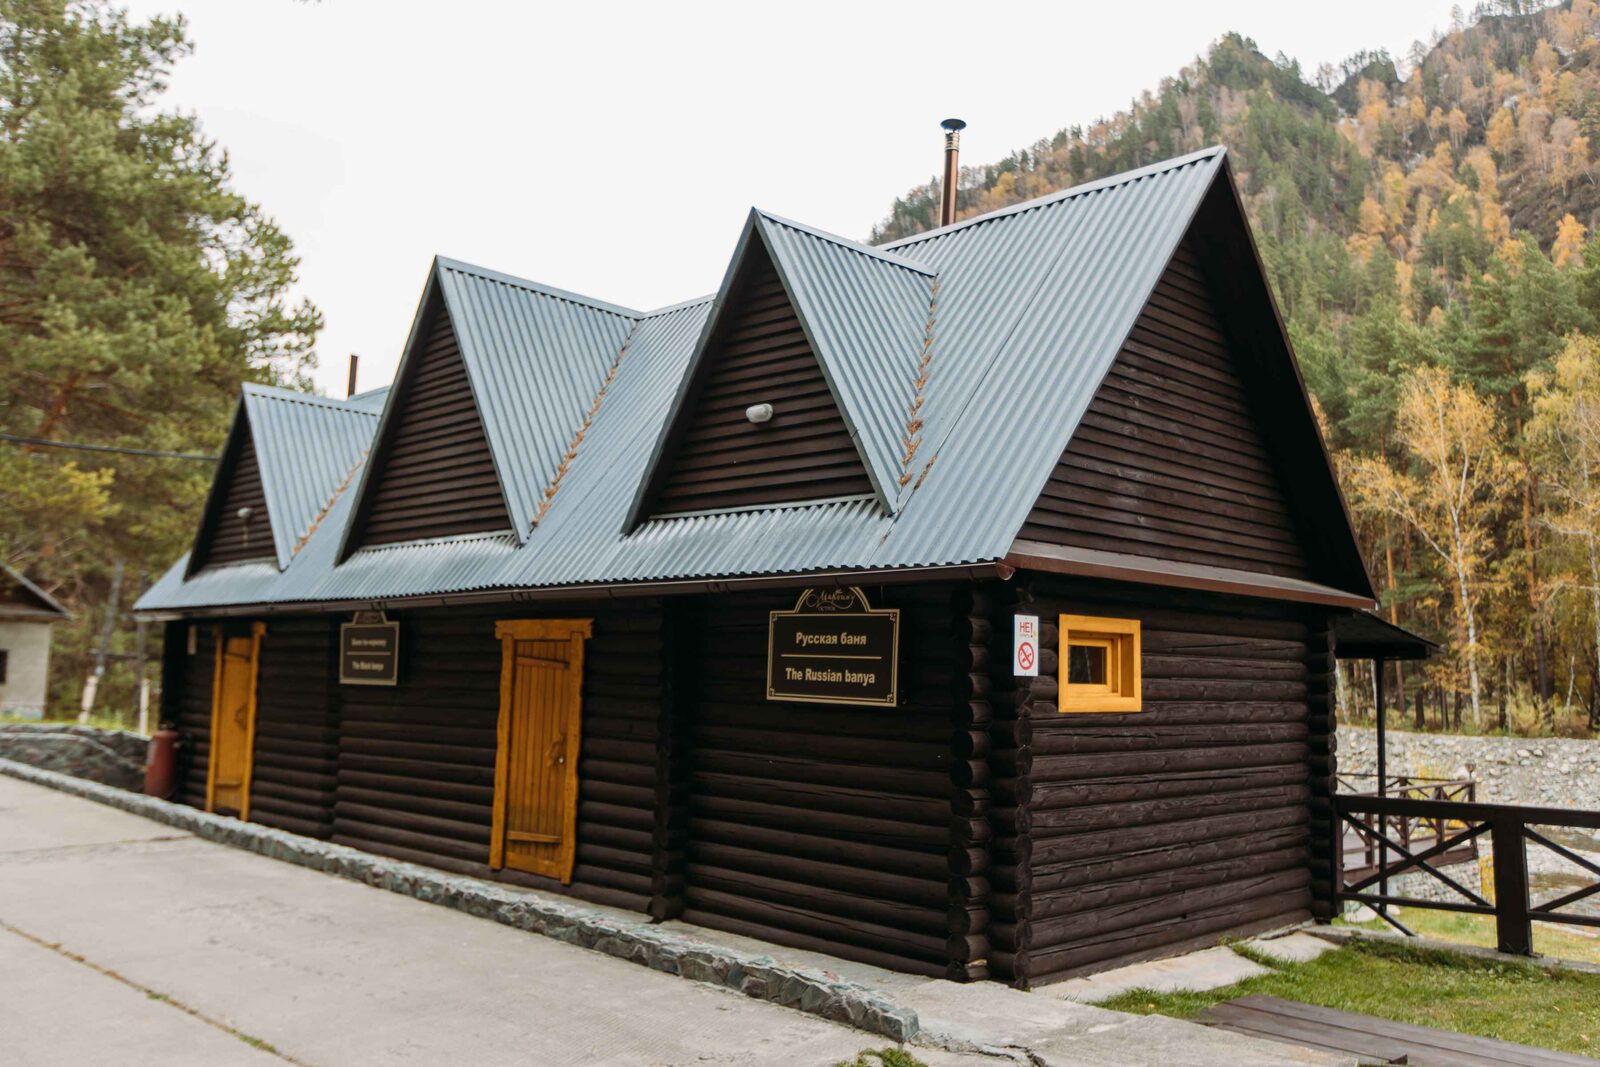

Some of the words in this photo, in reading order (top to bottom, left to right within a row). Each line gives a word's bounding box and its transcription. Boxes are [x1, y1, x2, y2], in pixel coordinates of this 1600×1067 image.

[795, 631, 838, 647] Русская
[840, 632, 867, 645] баня
[785, 667, 803, 680] The
[805, 668, 842, 682] Russian
[844, 669, 875, 687] banya
